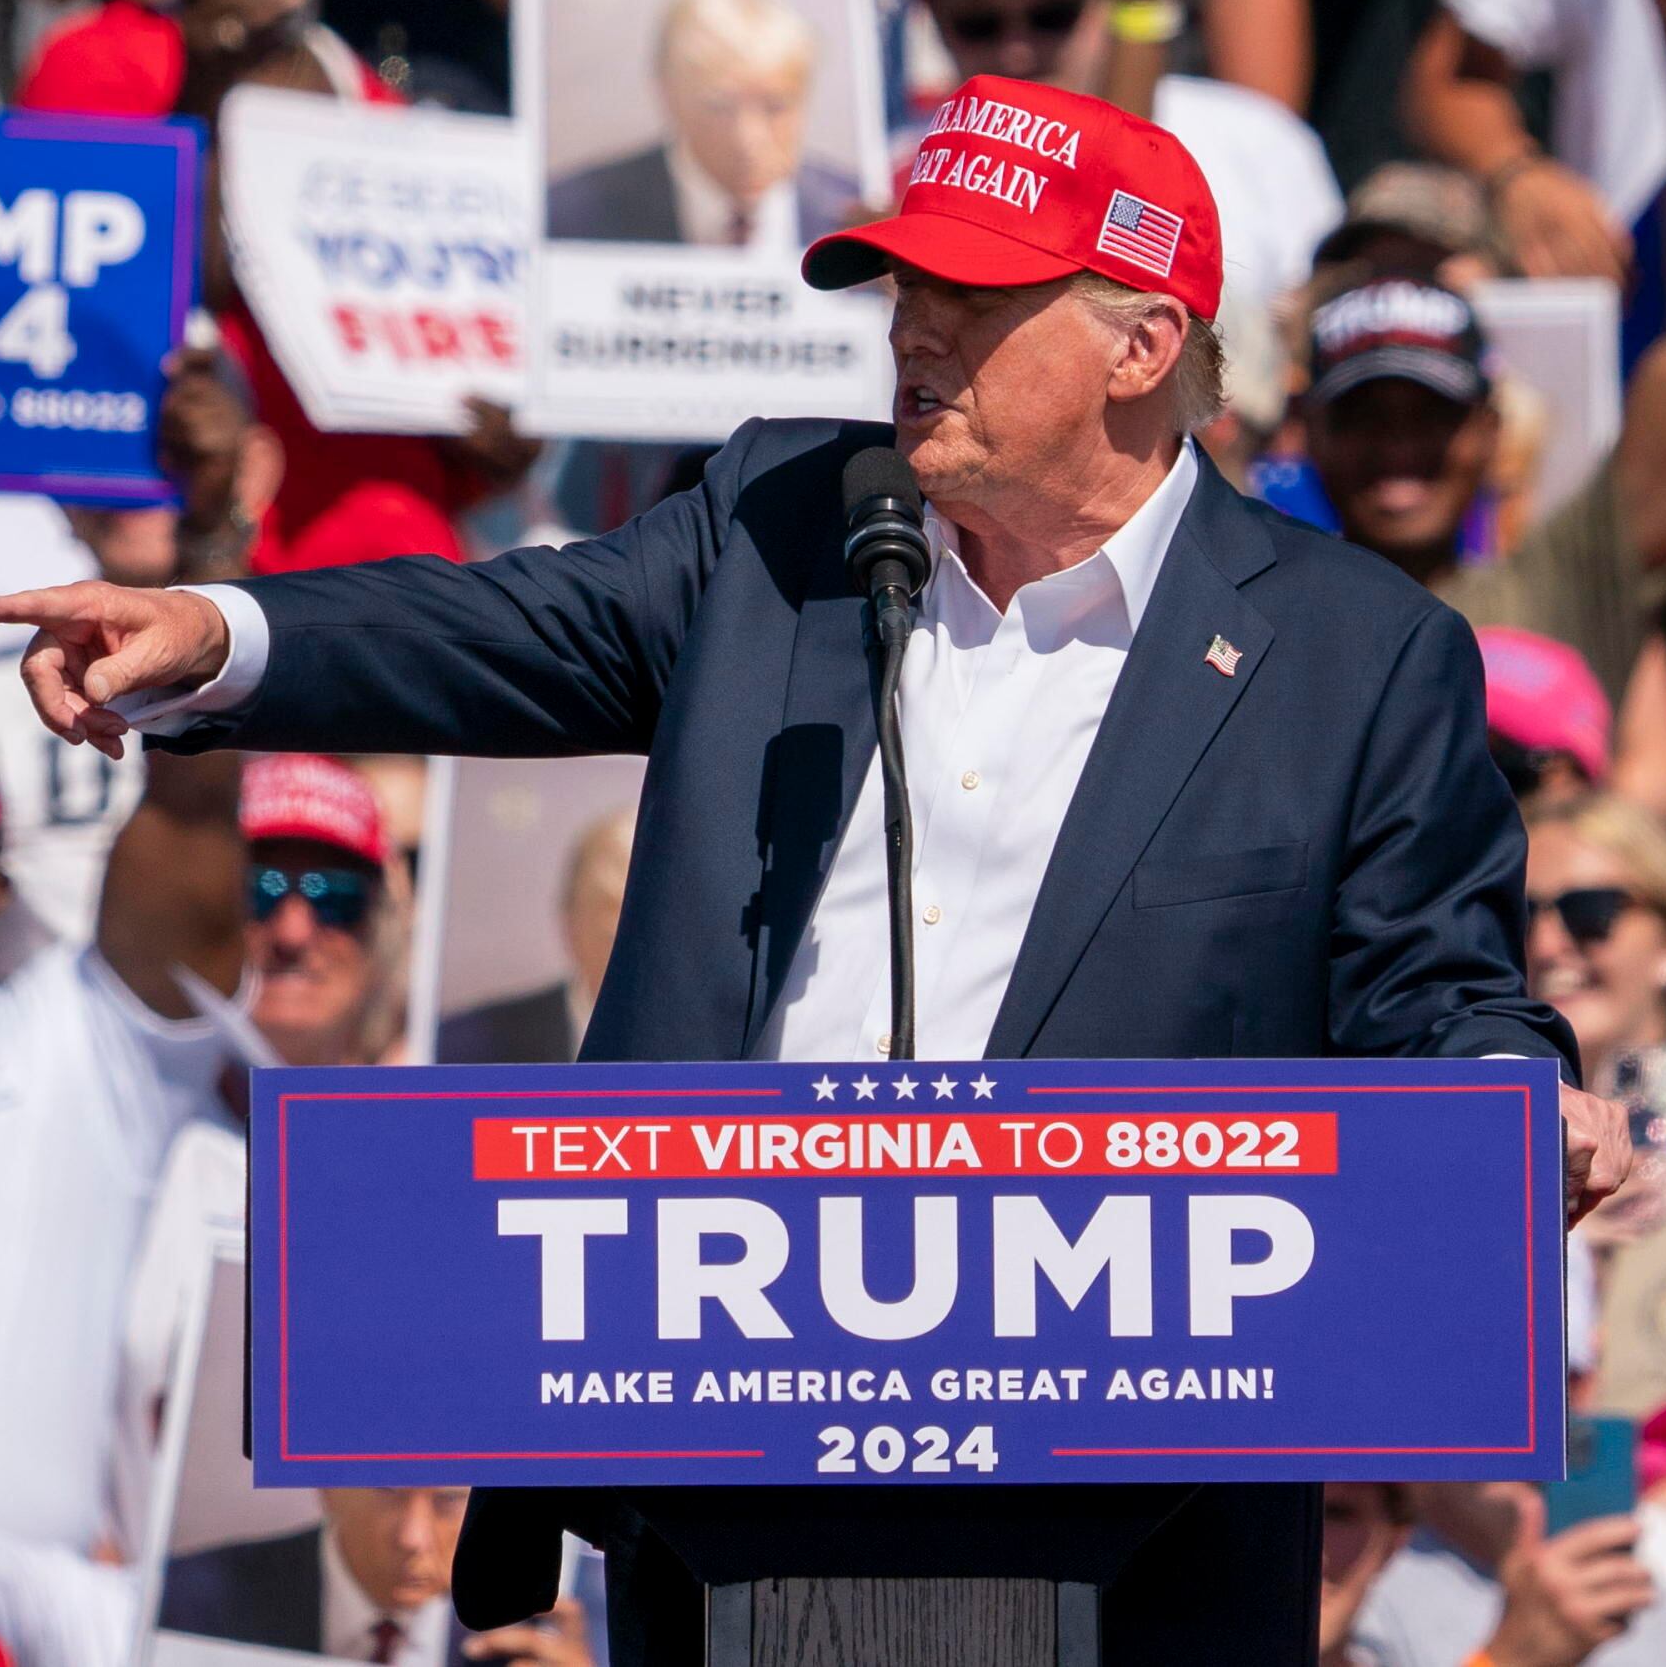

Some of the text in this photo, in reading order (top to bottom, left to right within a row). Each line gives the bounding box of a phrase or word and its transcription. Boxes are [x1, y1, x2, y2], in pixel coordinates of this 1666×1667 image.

[945, 96, 1081, 170] AMERICA
[942, 150, 1049, 215] AGAIN
[511, 1120, 1301, 1173] TEXT VIRGINIA TO 88022
[497, 1194, 1315, 1342] TRUMP
[540, 1368, 1276, 1404] MAKE AMERICA GREAT AGAIN!
[816, 1426, 999, 1474] 2024
